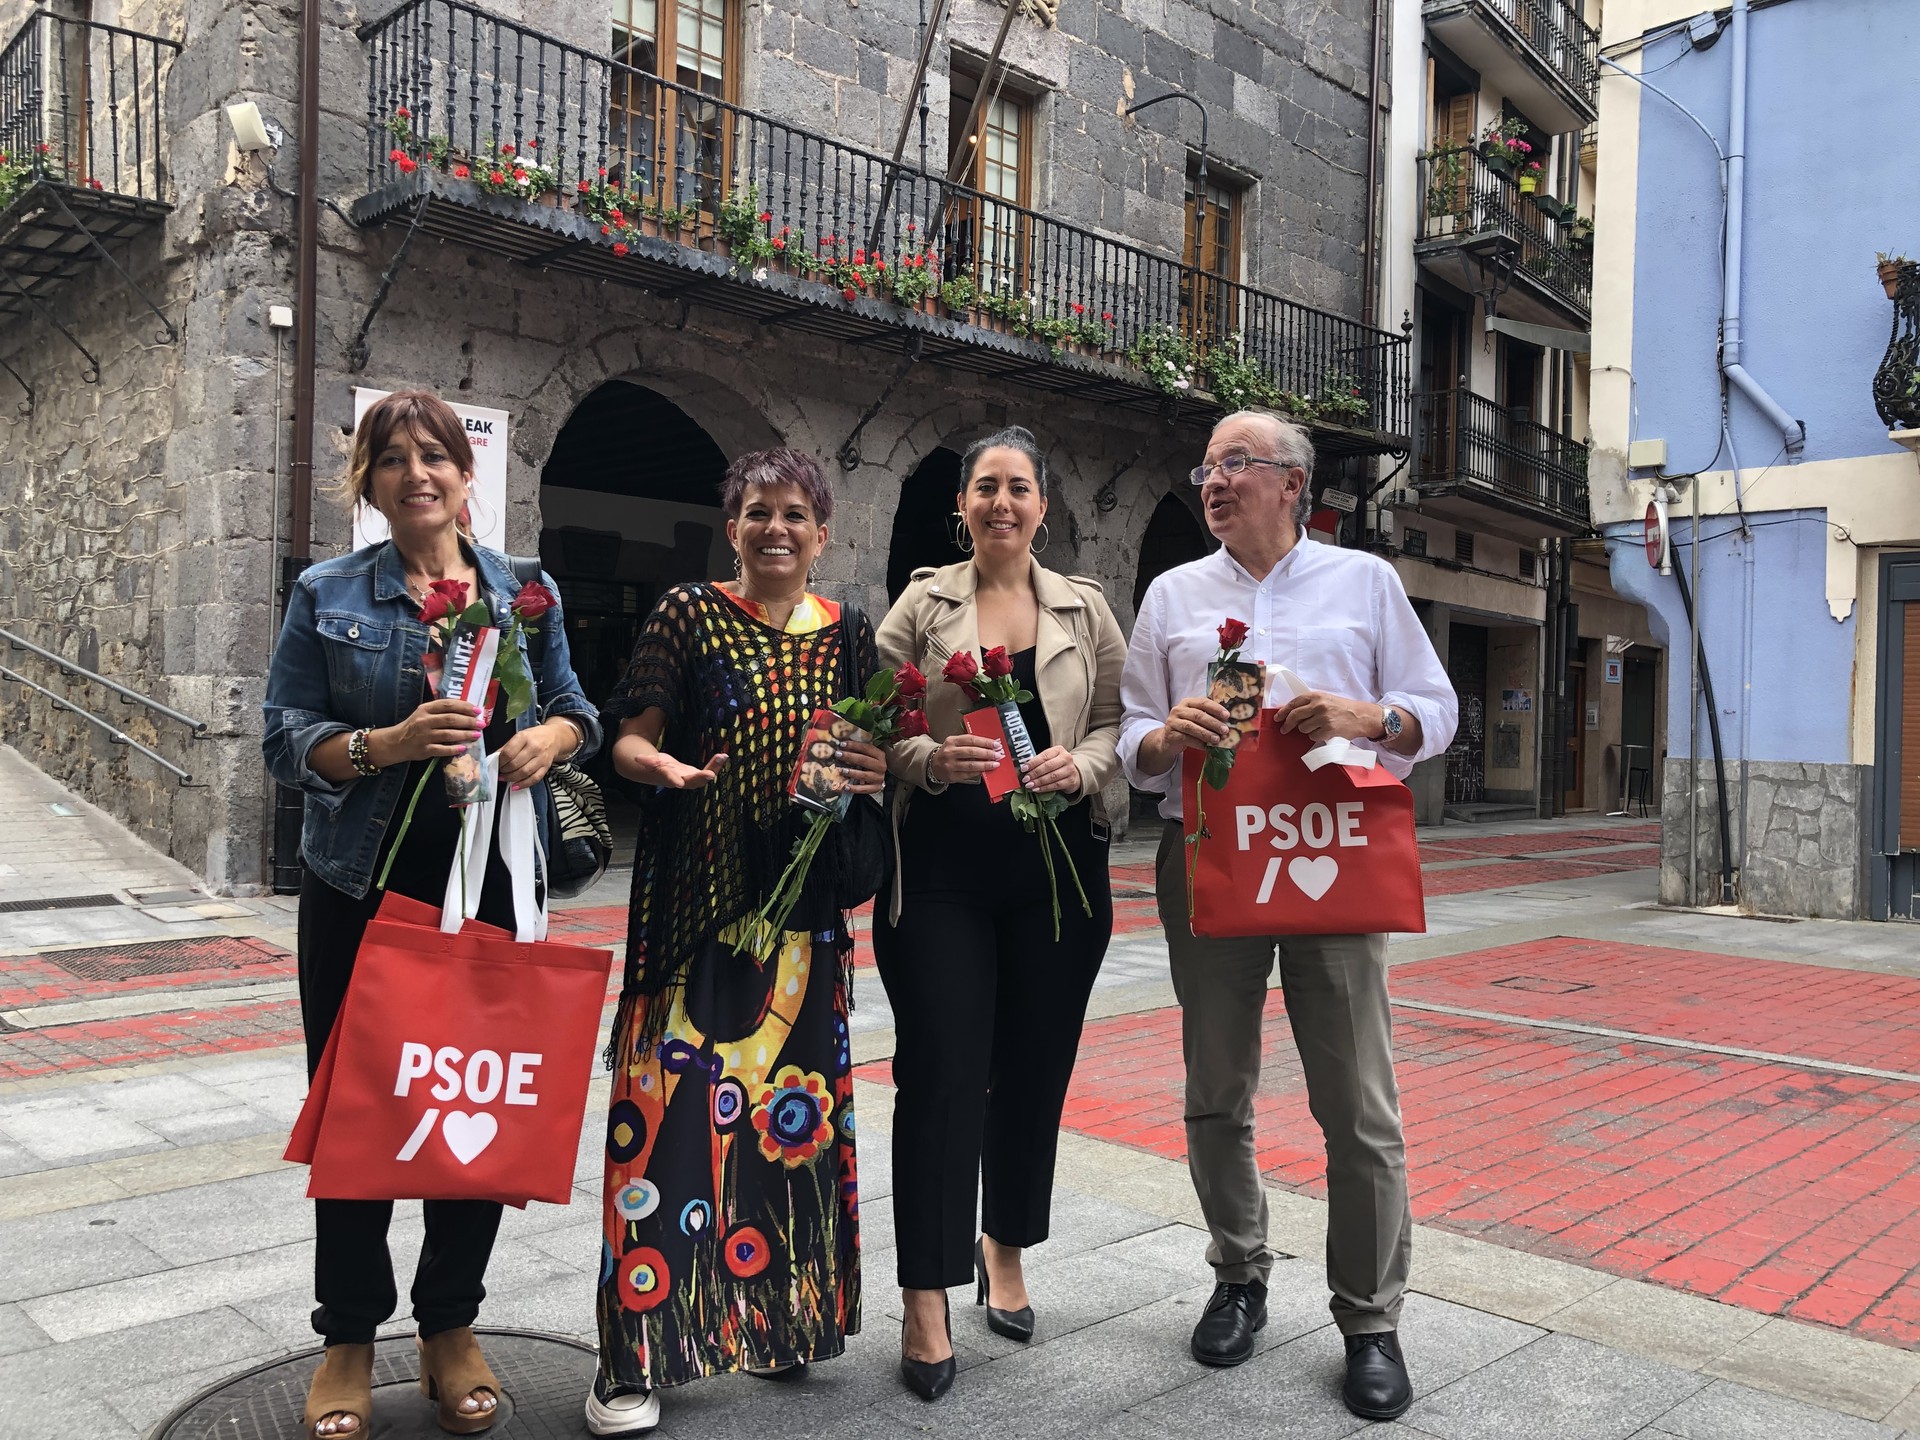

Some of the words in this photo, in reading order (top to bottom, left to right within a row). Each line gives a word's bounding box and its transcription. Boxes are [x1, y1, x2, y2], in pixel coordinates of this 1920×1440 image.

[464, 417, 493, 435] EAK
[468, 436, 488, 447] GRE
[446, 636, 476, 700] DELANTE
[1004, 710, 1036, 771] ADELANT
[1234, 801, 1369, 851] PSOE
[393, 1041, 543, 1106] PSOE
